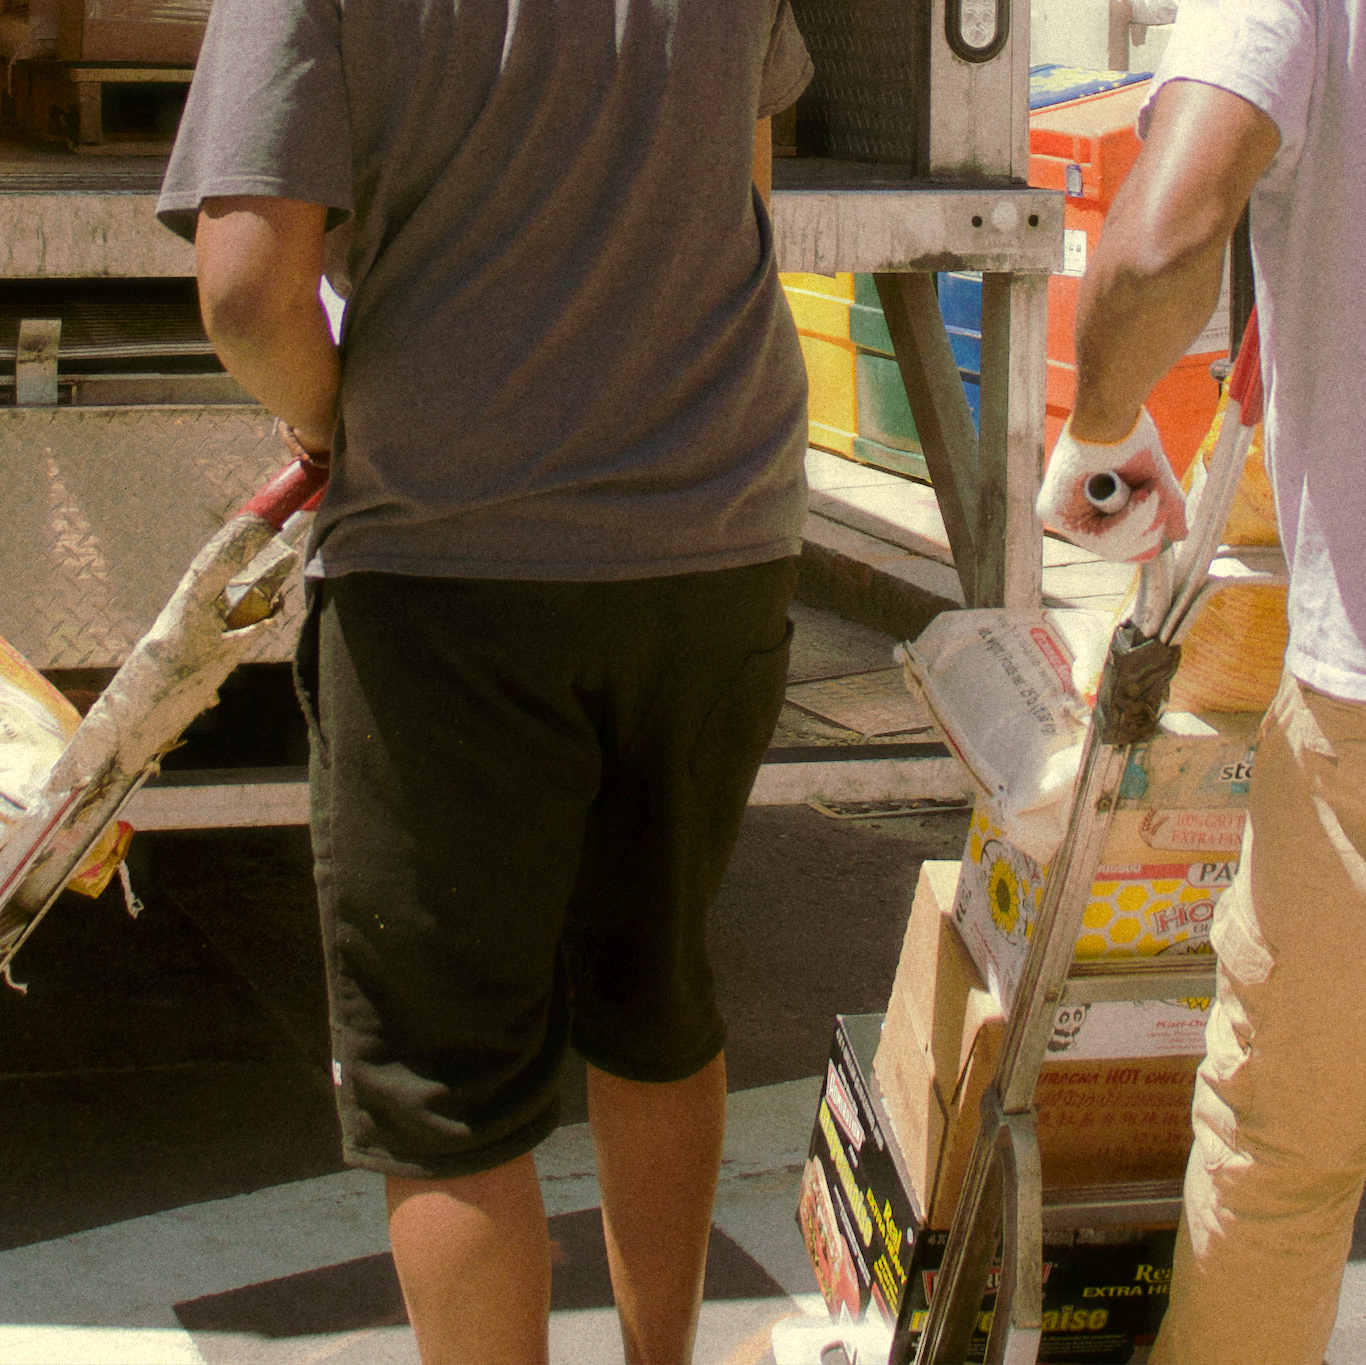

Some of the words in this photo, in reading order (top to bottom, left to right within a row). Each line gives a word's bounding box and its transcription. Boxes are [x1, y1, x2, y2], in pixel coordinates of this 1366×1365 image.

[1171, 830, 1214, 845] EXTRA
[1154, 897, 1215, 935] HO
[1156, 1020, 1207, 1029] Kari-Ou
[1105, 1068, 1143, 1084] HOT
[1135, 1264, 1173, 1283] Re
[1082, 1285, 1142, 1298] EXTRA
[1148, 1284, 1171, 1296] HE
